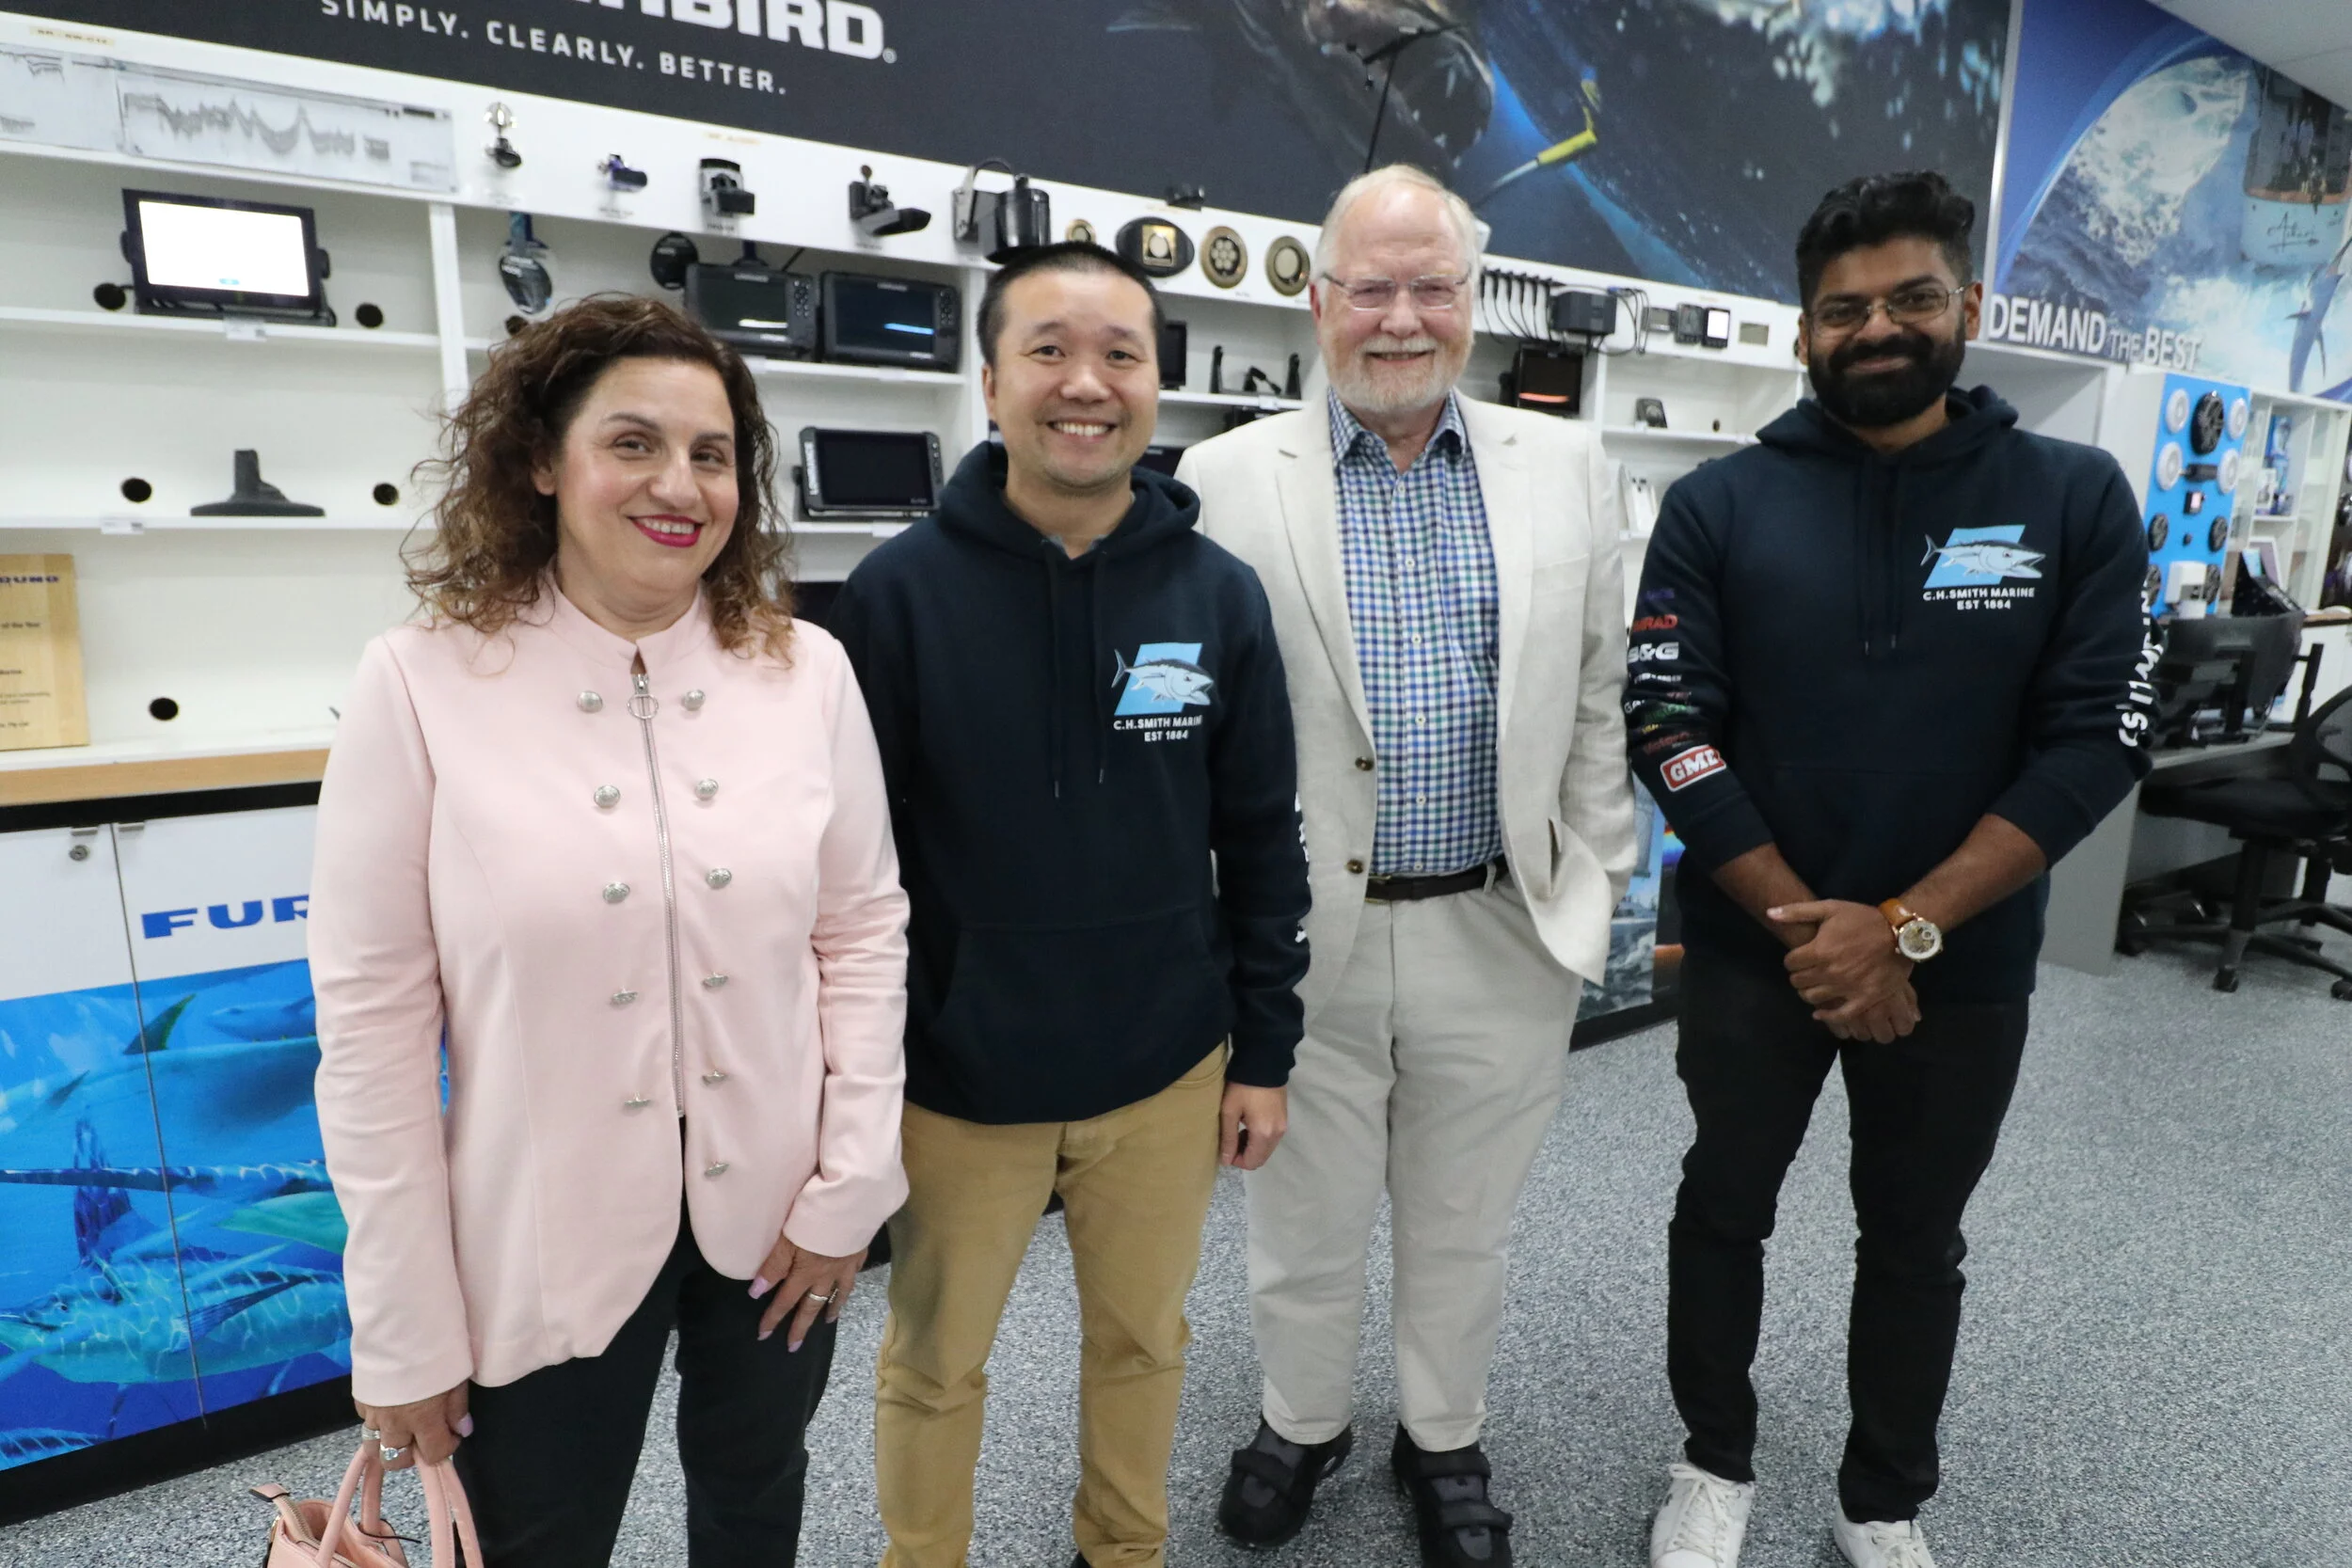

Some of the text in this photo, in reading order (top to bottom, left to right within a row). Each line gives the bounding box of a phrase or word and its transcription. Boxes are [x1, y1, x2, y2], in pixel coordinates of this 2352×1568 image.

[321, 0, 787, 95] SIMPLY. CLEARLY. BETTER.
[1989, 293, 2201, 372] DEMAND THE BEST
[1922, 587, 2035, 601] C.H.SMITH MARINE
[1957, 600, 1980, 610] EST
[1113, 718, 1171, 731] C.H.SMITH
[1144, 731, 1163, 742] EST
